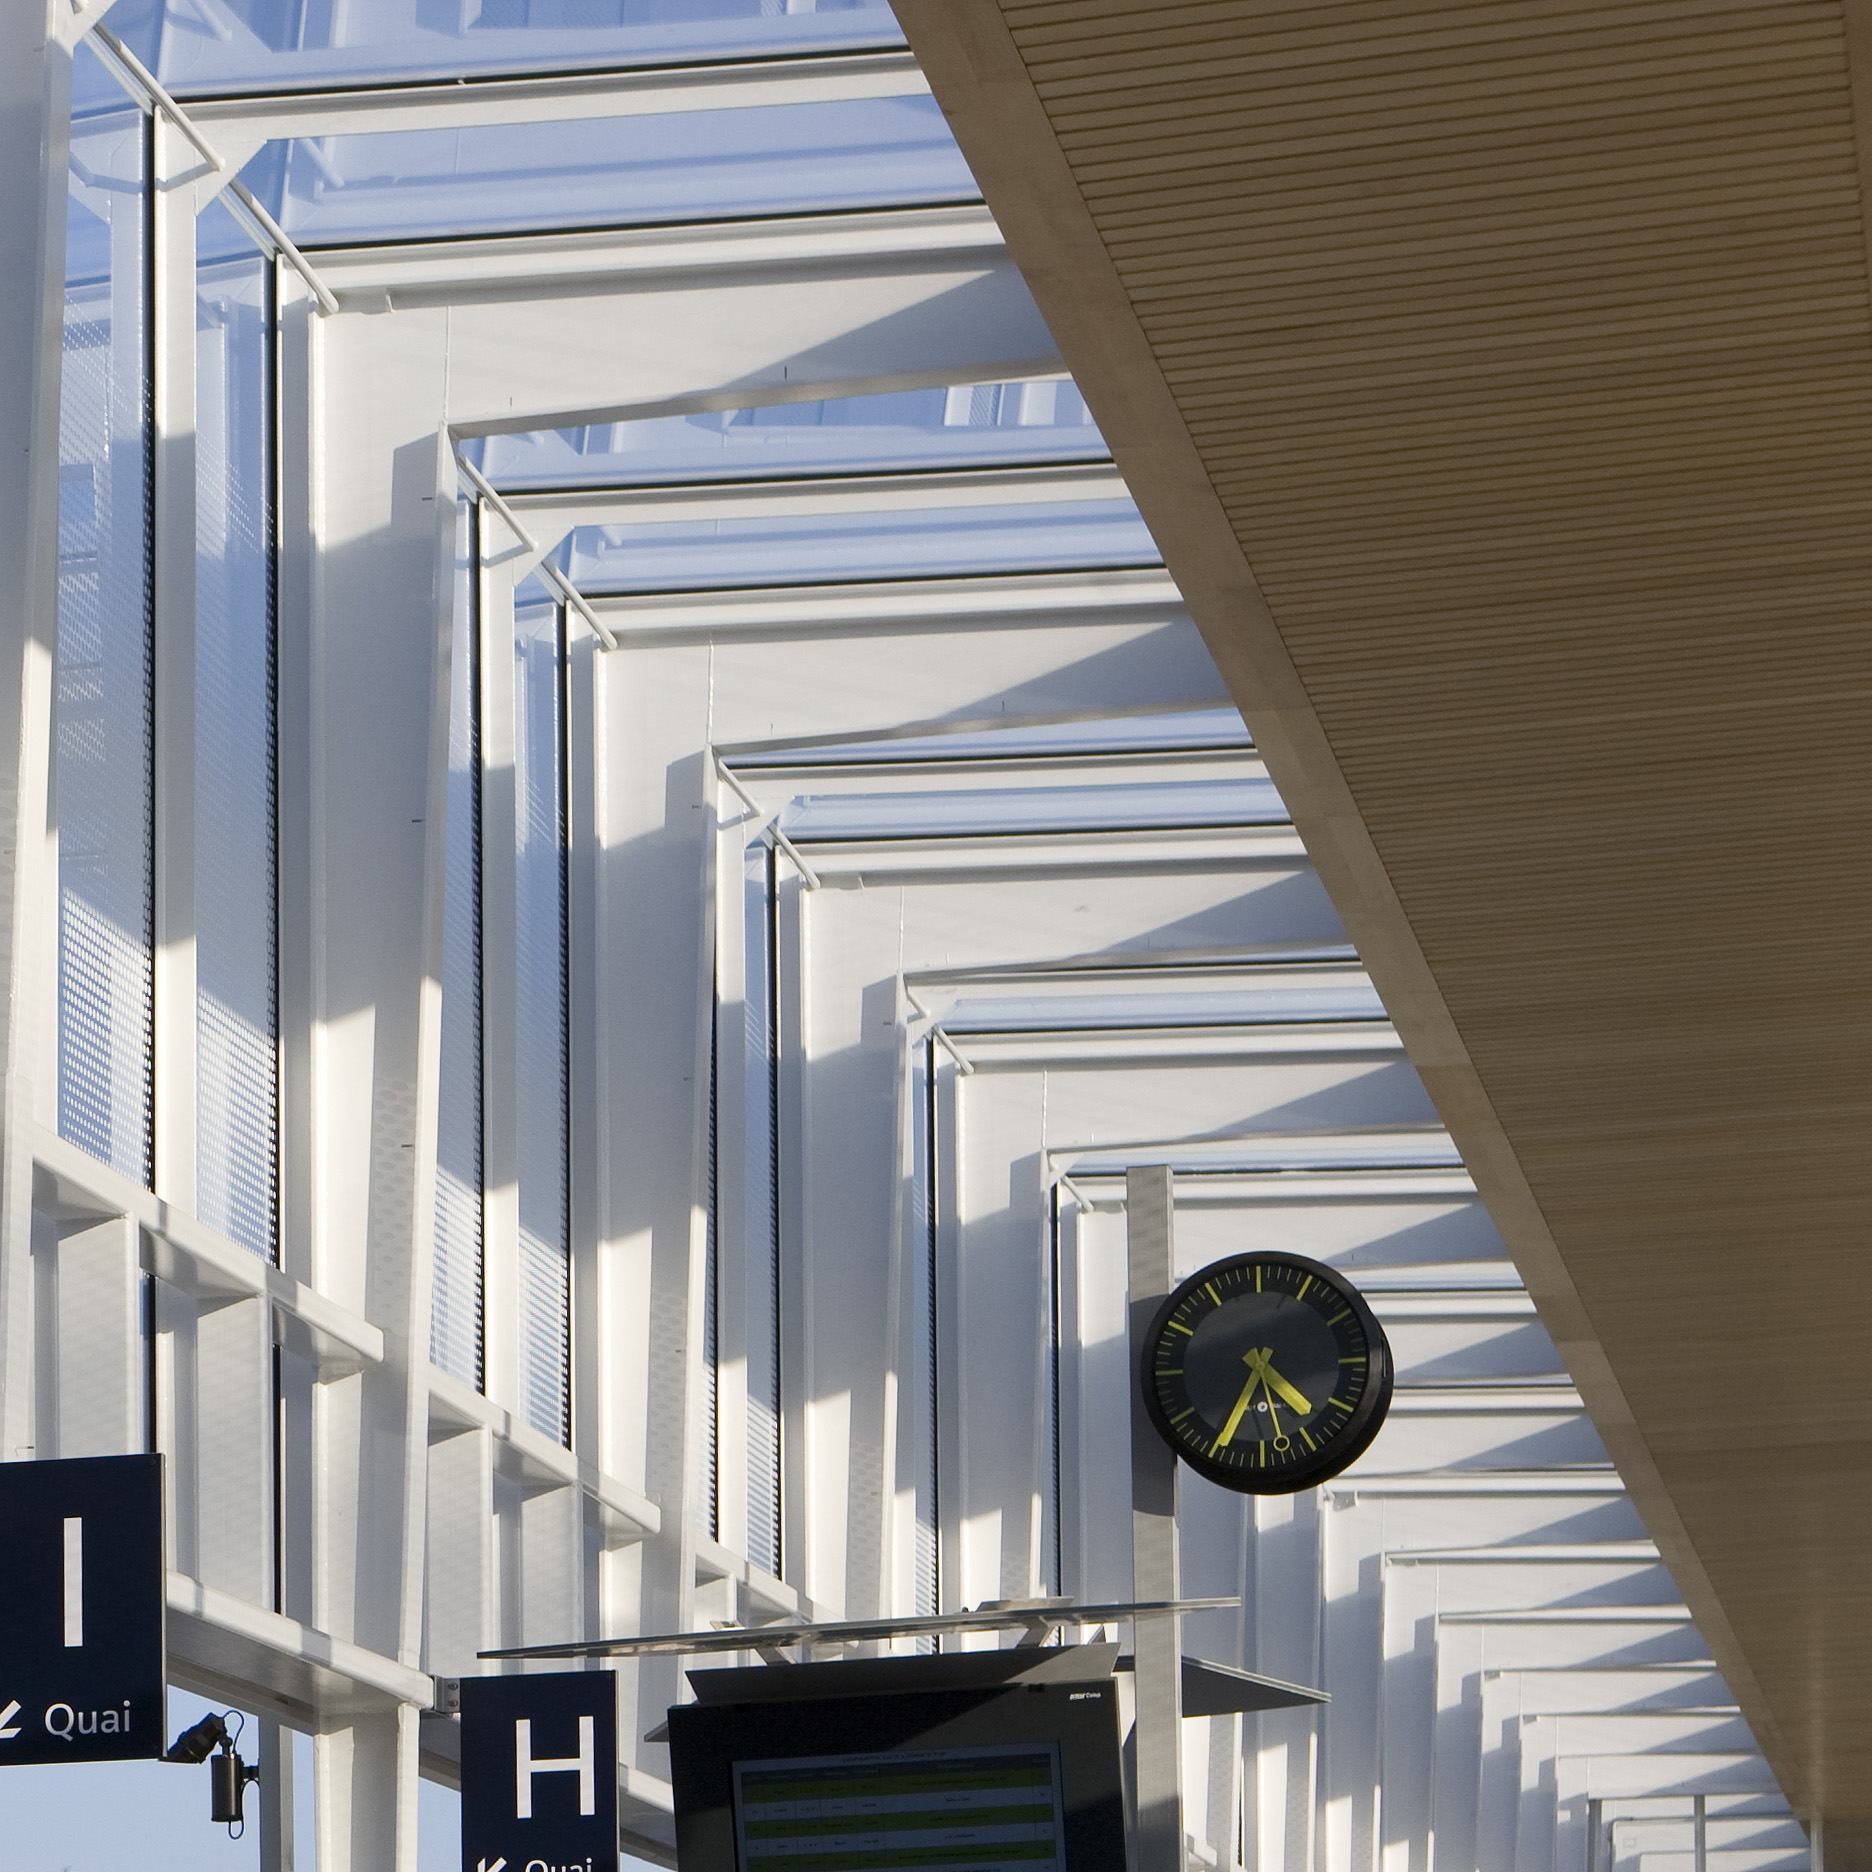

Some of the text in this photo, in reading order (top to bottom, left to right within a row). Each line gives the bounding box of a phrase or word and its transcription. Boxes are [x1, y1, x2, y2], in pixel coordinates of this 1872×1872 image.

[63, 1517, 84, 1648] I
[45, 1700, 131, 1742] Quai
[515, 1716, 595, 1819] H
